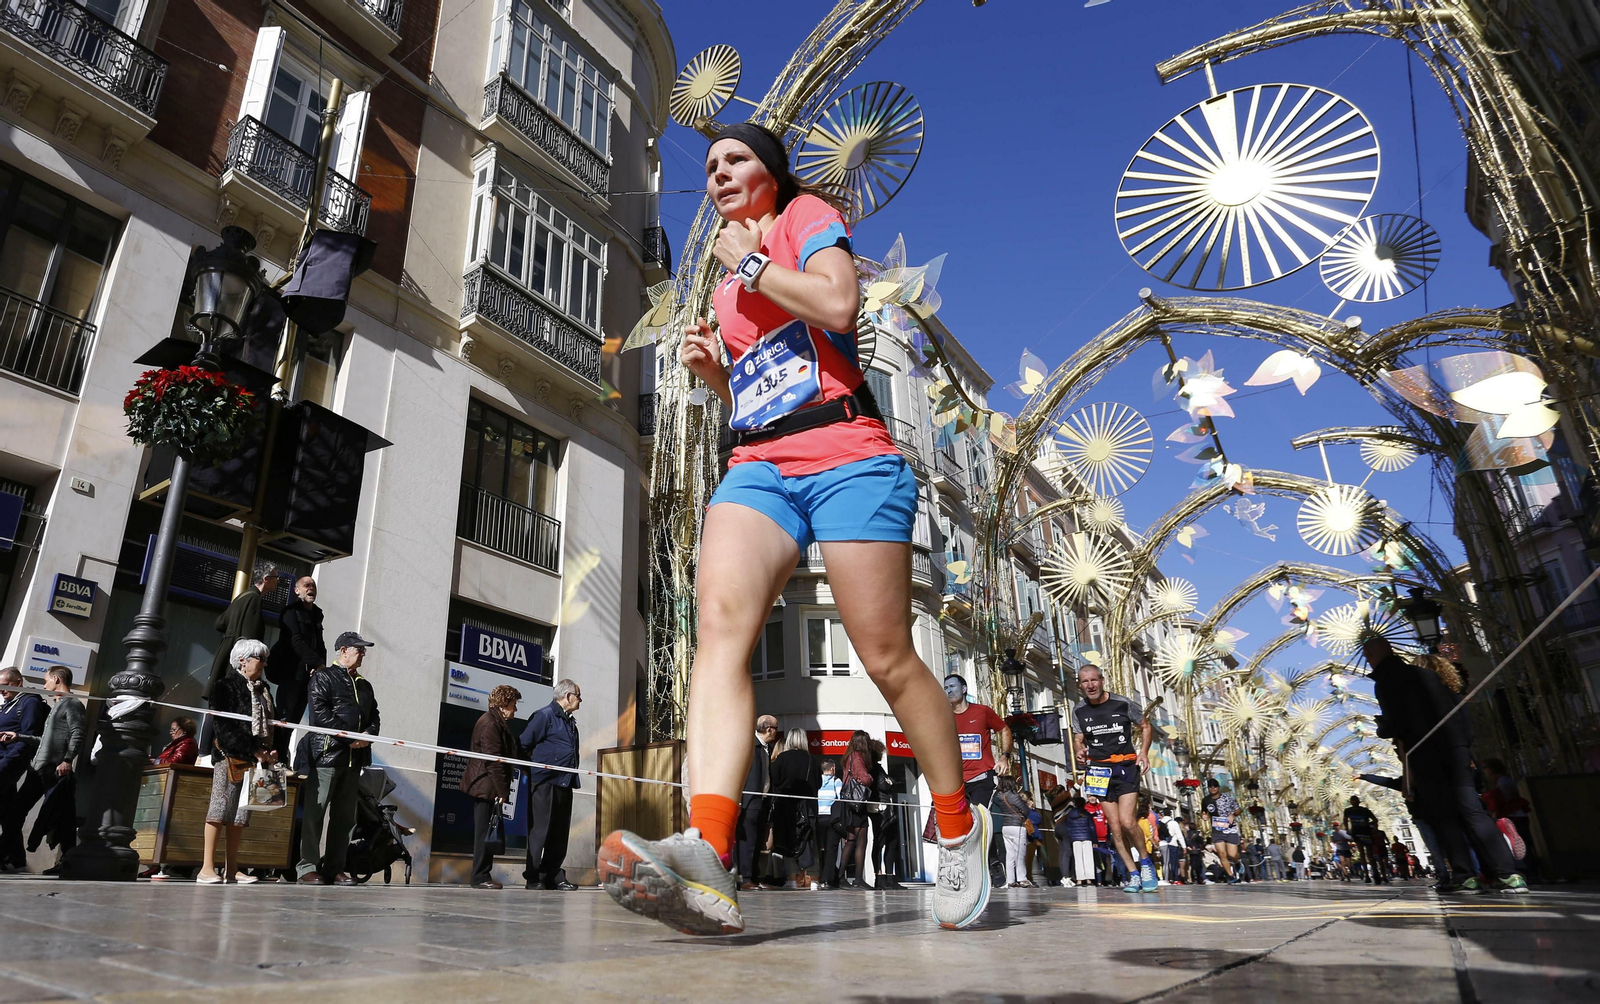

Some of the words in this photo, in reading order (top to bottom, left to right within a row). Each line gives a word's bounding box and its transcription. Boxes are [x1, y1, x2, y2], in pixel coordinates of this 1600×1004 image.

[754, 339, 788, 365] ZURICH
[77, 480, 84, 489] 14
[59, 580, 91, 597] BBVA
[33, 643, 60, 656] BBVA
[478, 633, 528, 667] BBVA
